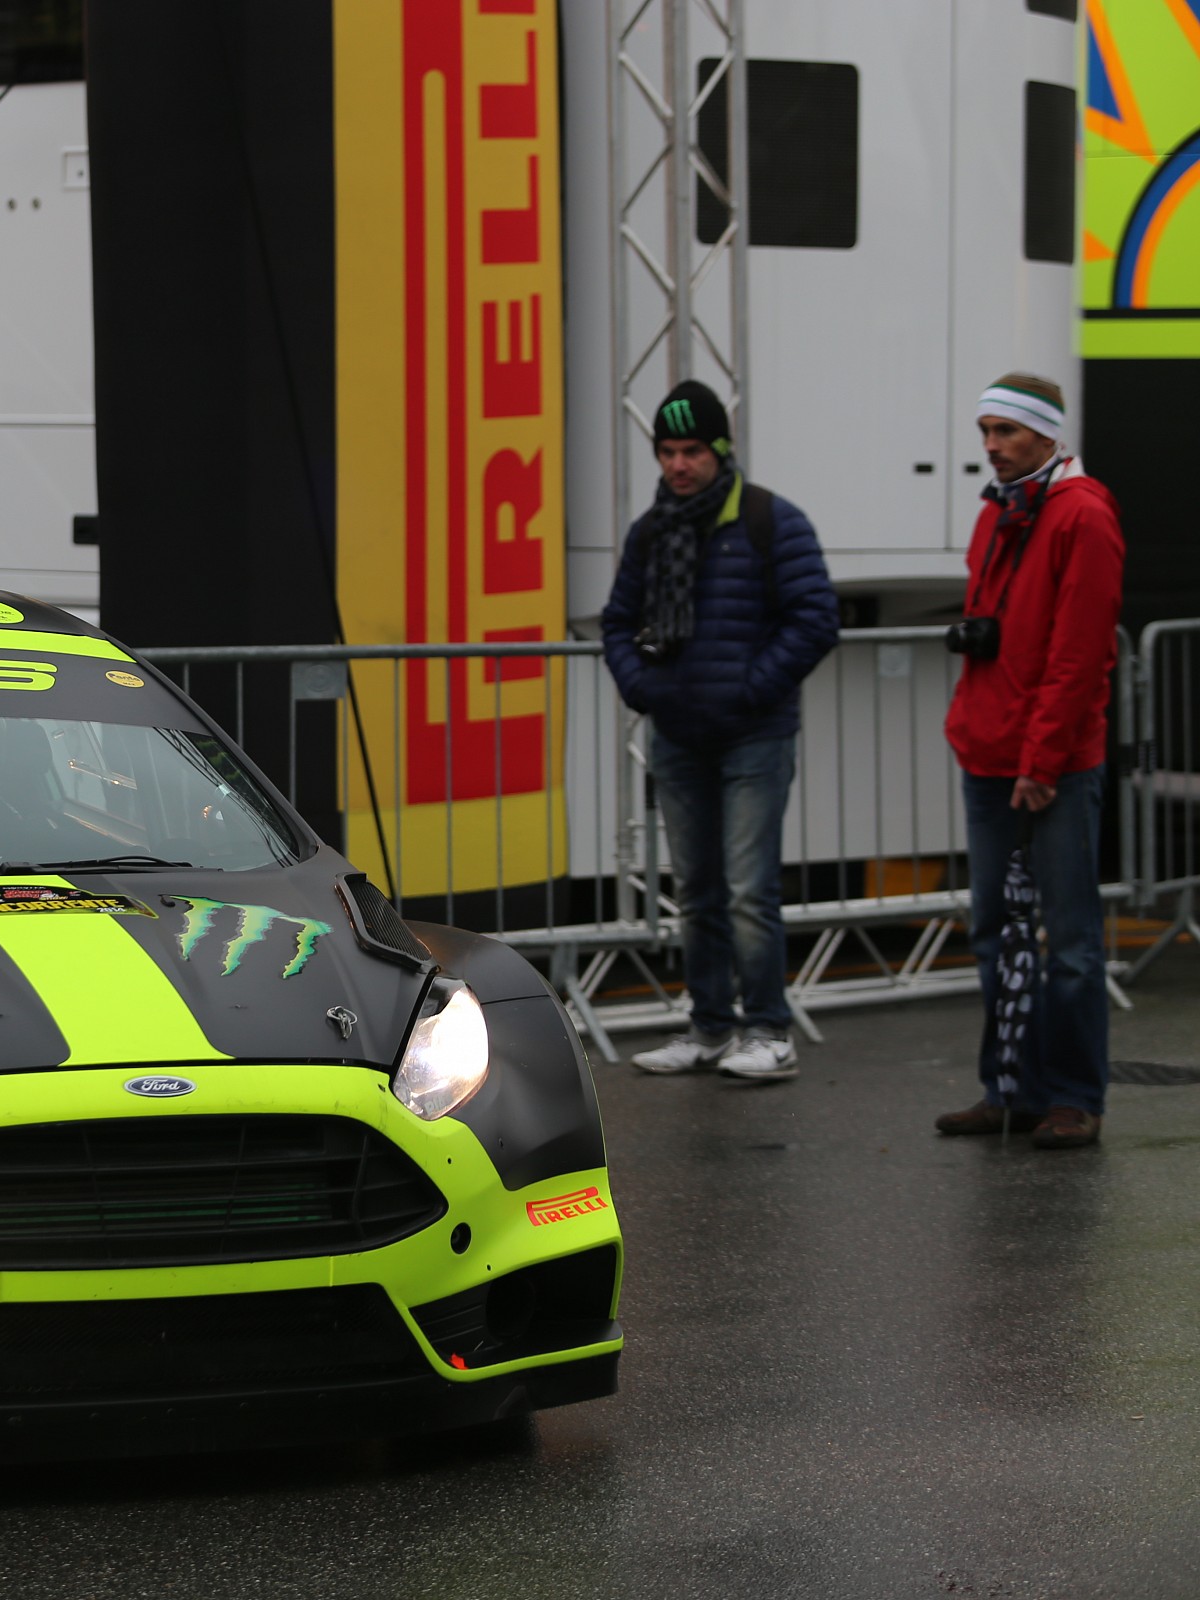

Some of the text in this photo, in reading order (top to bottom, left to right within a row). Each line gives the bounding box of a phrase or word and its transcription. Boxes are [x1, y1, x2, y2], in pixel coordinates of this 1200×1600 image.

[402, 0, 545, 805] PIRELL
[141, 1079, 180, 1091] Ford
[526, 1186, 608, 1227] PIRELLI
